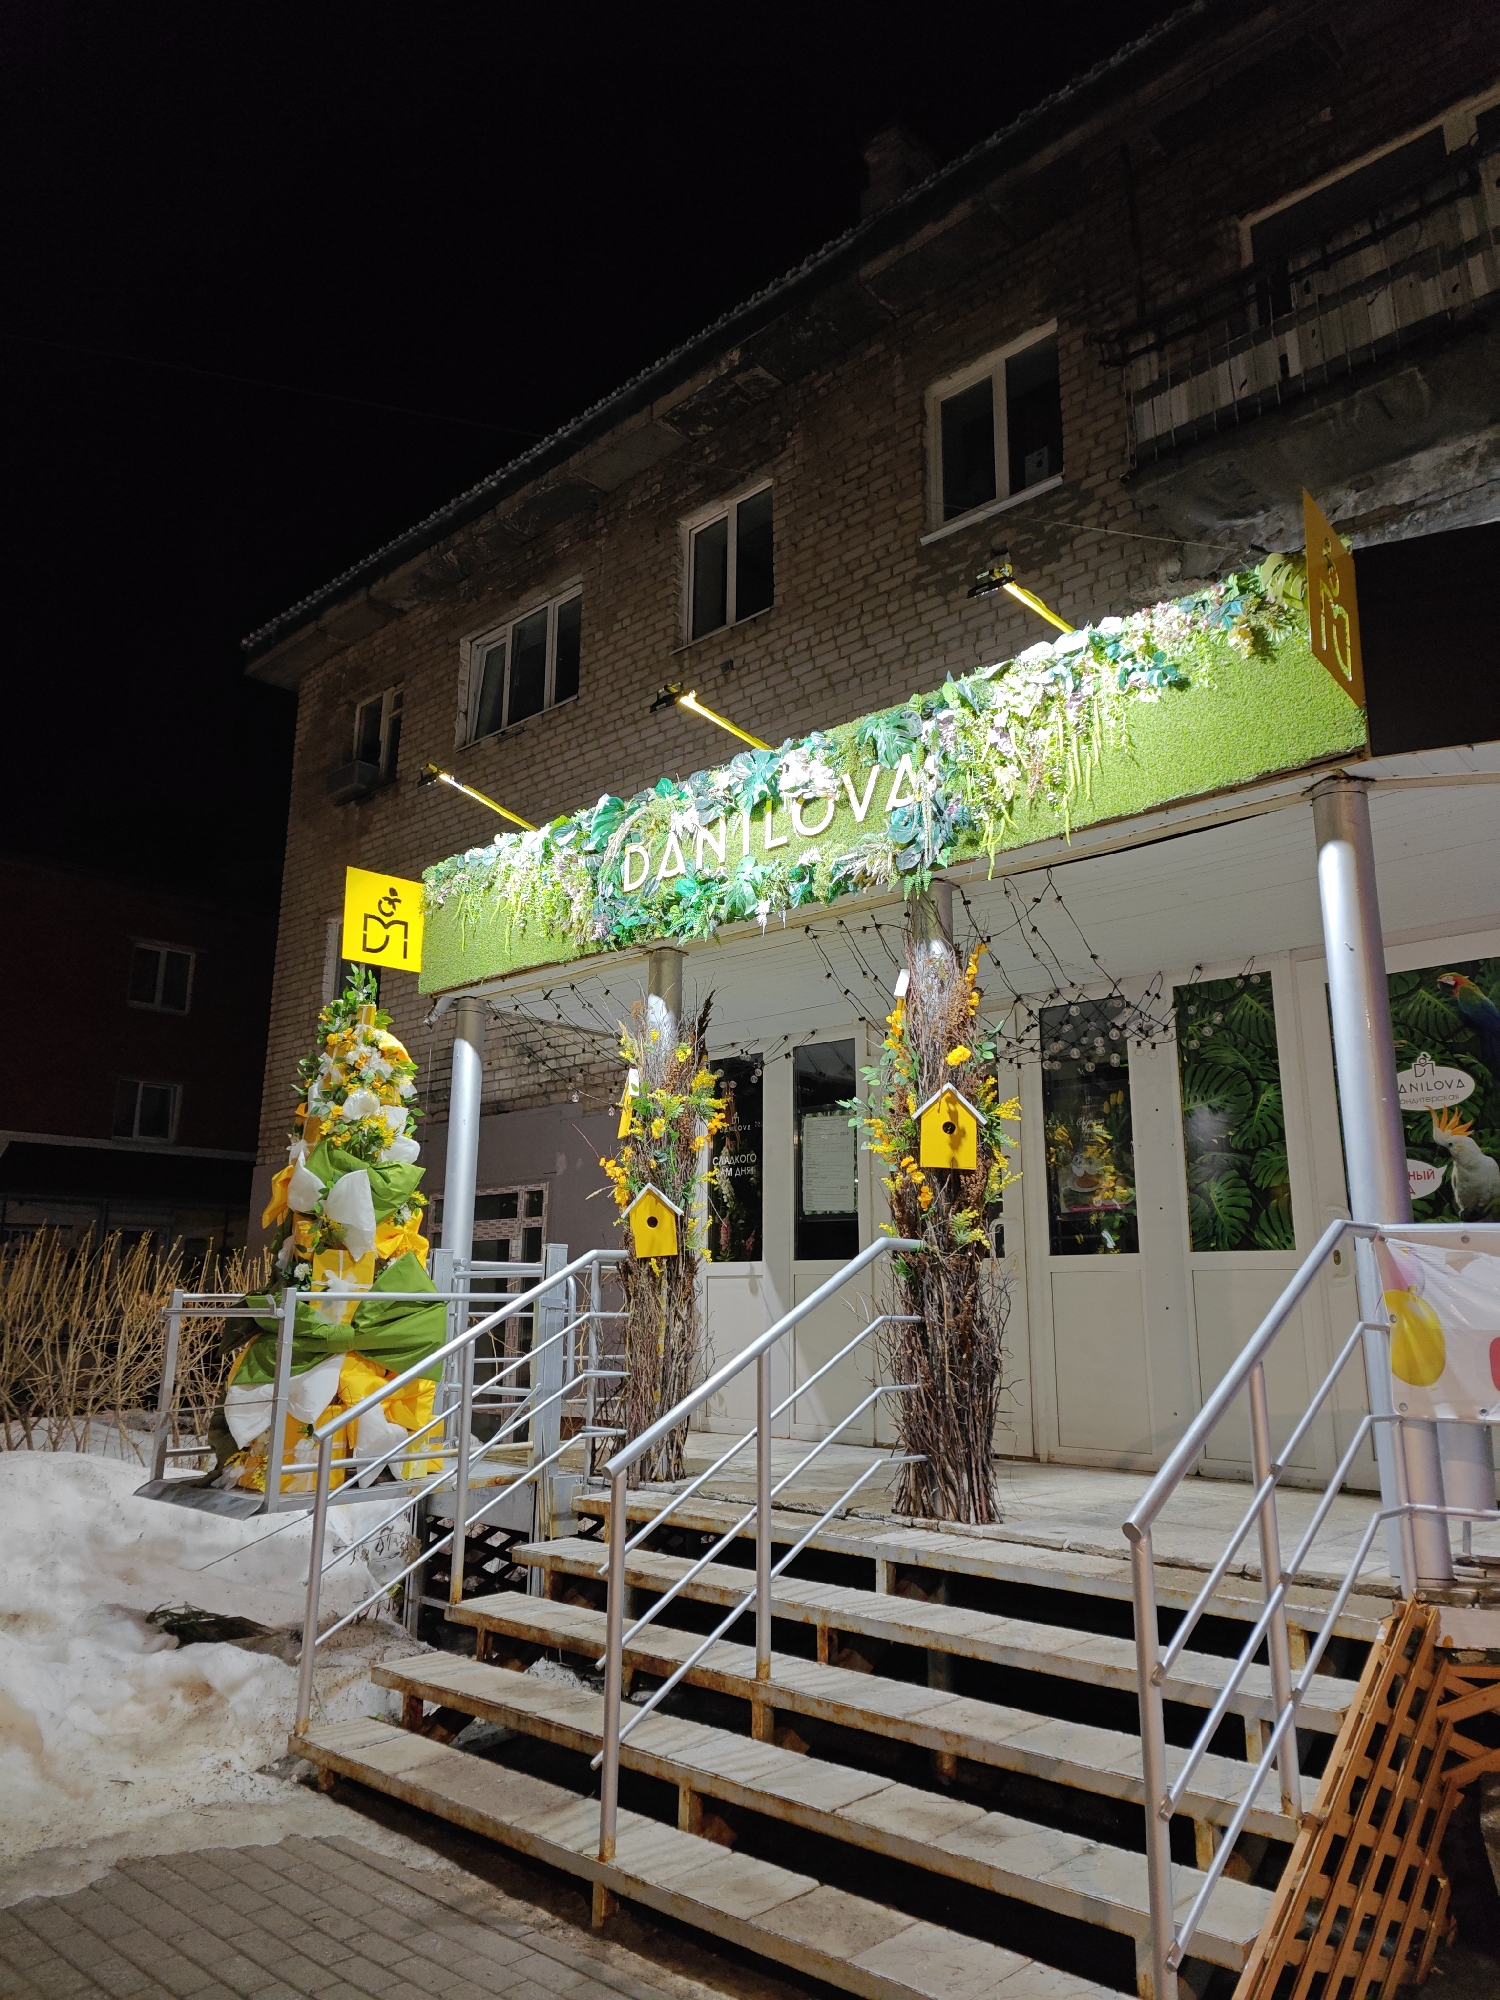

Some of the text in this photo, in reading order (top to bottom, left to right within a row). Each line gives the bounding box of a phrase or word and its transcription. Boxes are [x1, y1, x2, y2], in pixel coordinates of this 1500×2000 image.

[623, 752, 917, 893] DANILOVA
[1399, 1078, 1465, 1093] ANILOVA
[1400, 1094, 1460, 1106] ондитерская
[1408, 1168, 1435, 1181] НЫЙ
